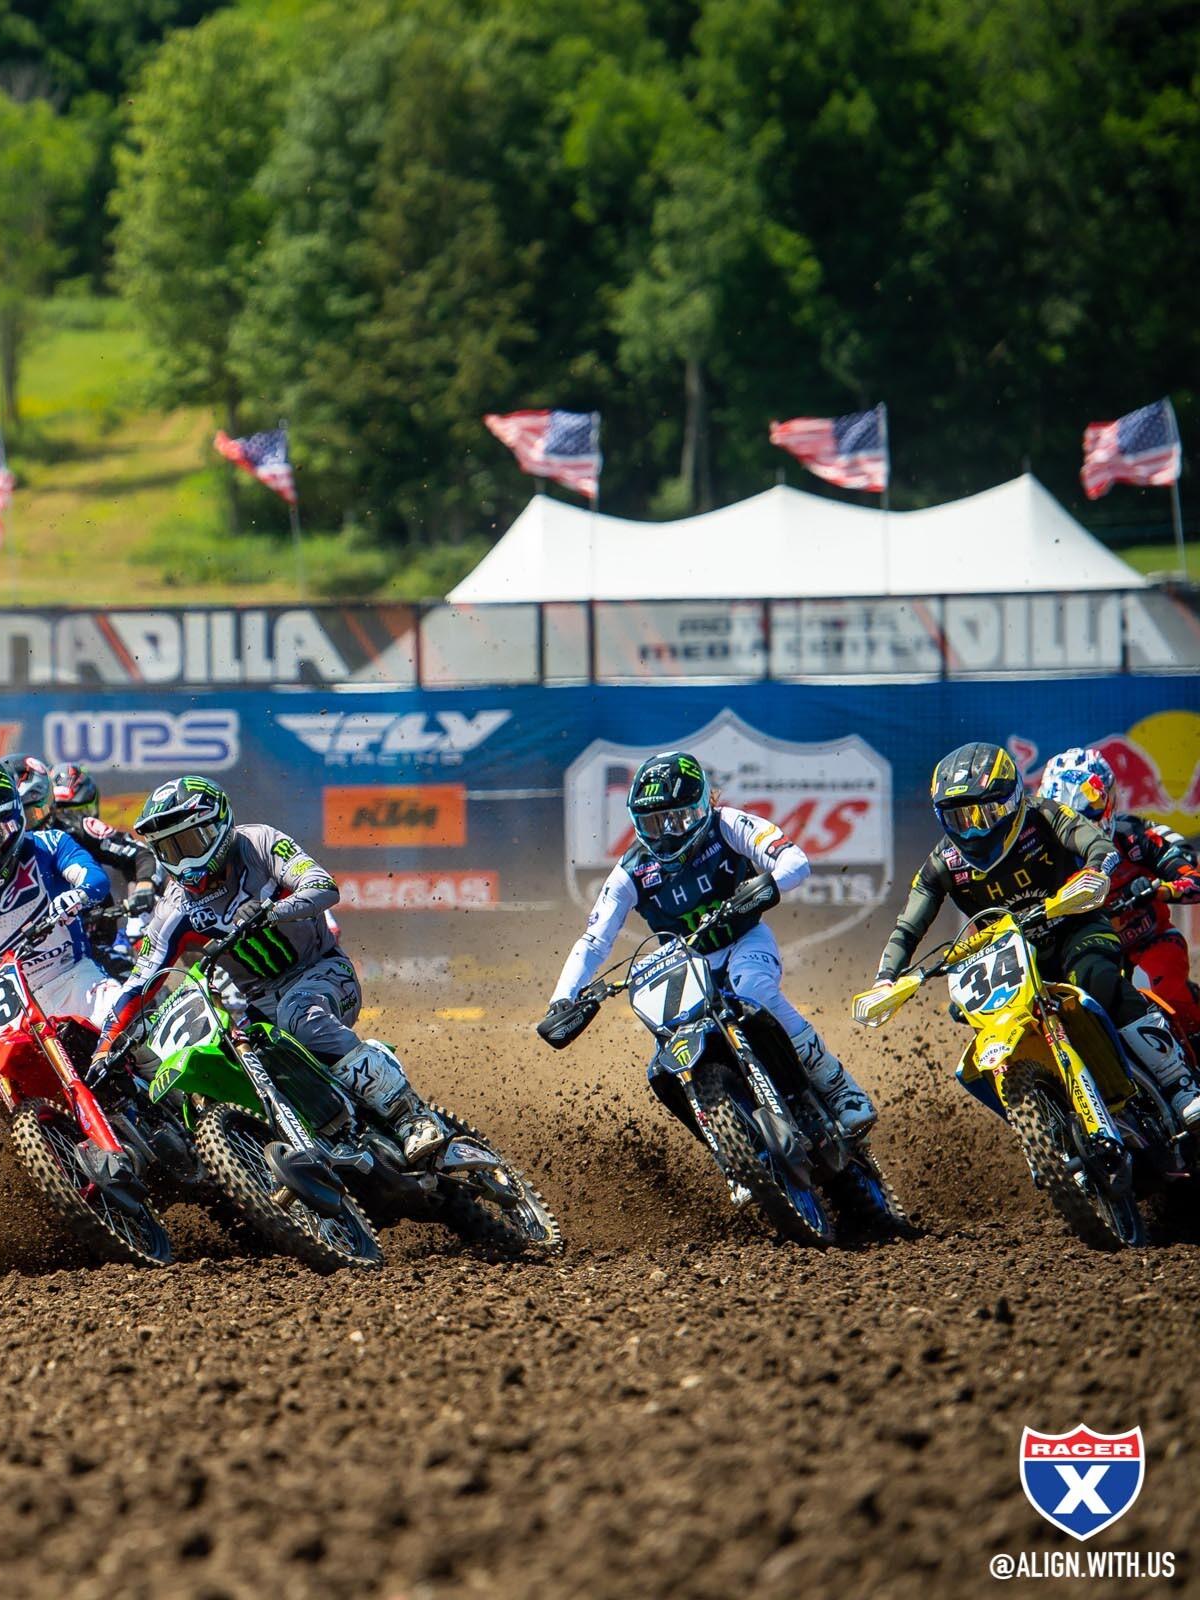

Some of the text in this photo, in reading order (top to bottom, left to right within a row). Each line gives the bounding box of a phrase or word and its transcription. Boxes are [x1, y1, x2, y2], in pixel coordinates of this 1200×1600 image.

[44, 709, 239, 772] WPS
[275, 710, 513, 755] FLY
[337, 877, 490, 909] ASGAS
[20, 940, 73, 970] ONDA
[643, 956, 677, 980] LUCAS OIL
[959, 944, 1024, 1013] 34
[963, 945, 997, 967] LUCAS OIL
[649, 962, 688, 1024] 7
[159, 995, 212, 1049] 3
[748, 1063, 783, 1115] DUNLOP
[1071, 1078, 1095, 1124] ACERBIS
[1080, 1074, 1108, 1127] DUNLOP
[279, 1102, 315, 1149] DUNLOP
[690, 1099, 719, 1152] DULOP
